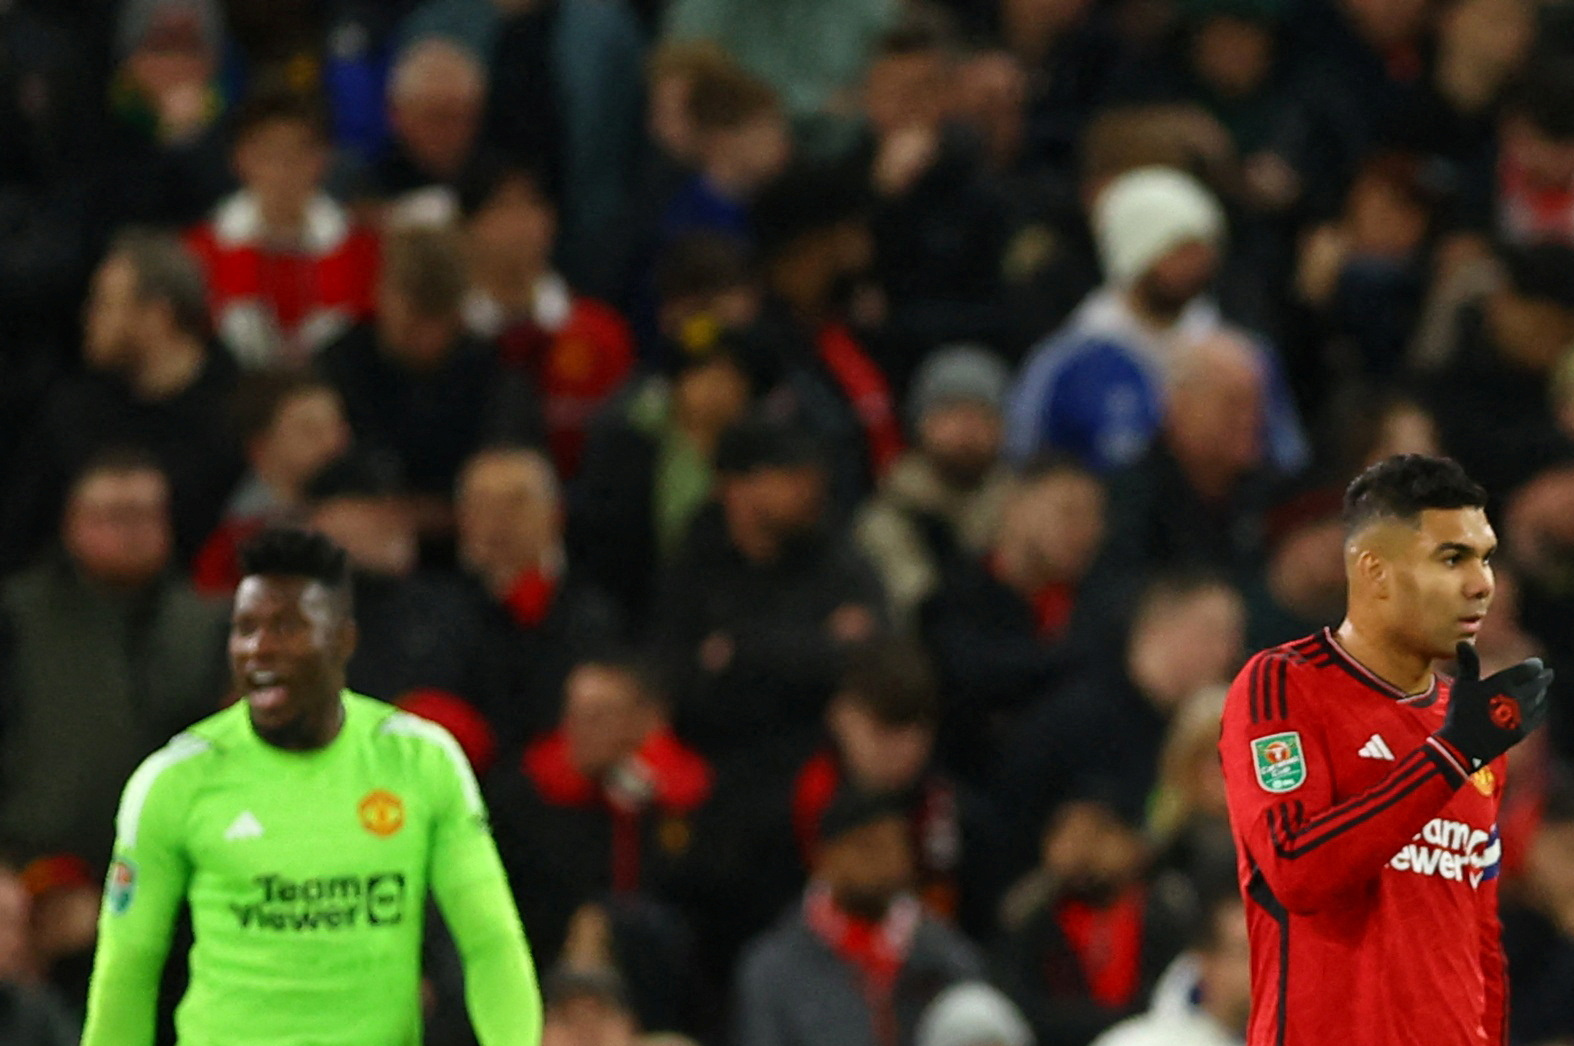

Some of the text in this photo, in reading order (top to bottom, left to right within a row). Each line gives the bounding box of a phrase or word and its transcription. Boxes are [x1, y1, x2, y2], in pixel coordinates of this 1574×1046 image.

[1412, 817, 1471, 851] am
[1384, 842, 1470, 883] ewer
[253, 872, 362, 903] Team
[229, 903, 358, 931] Viewer
